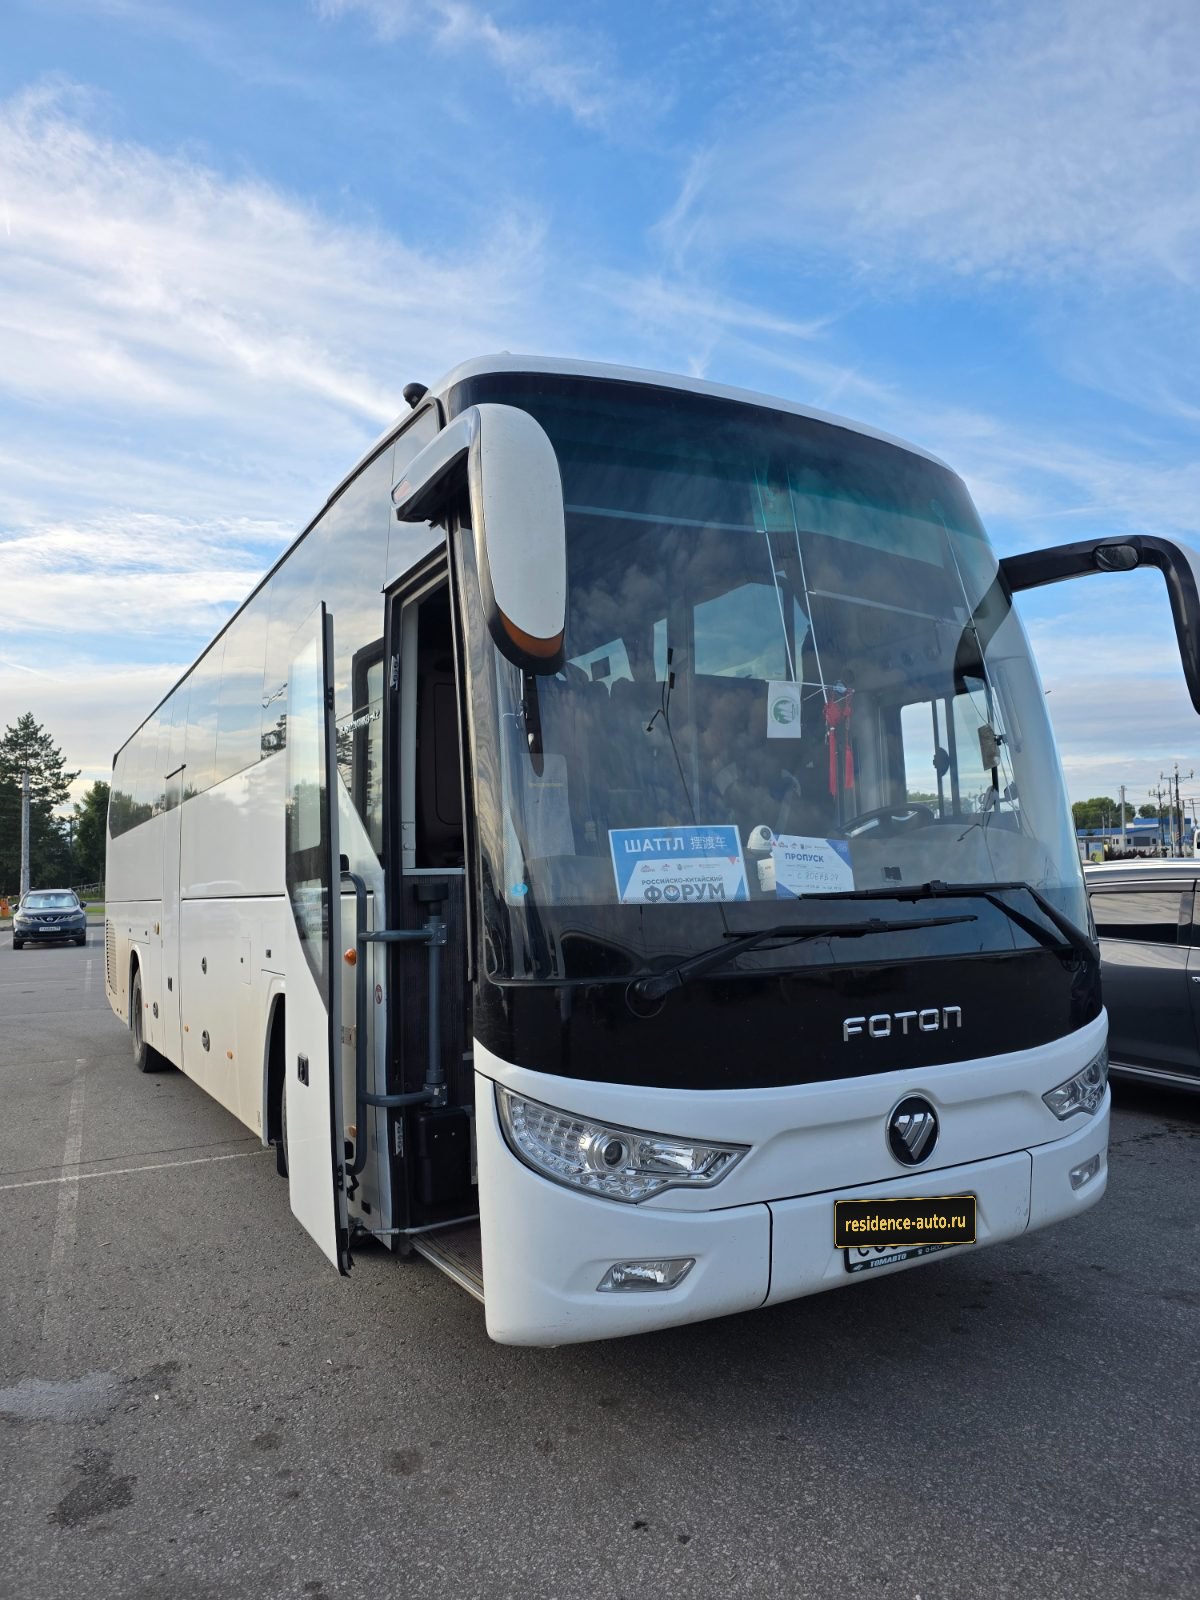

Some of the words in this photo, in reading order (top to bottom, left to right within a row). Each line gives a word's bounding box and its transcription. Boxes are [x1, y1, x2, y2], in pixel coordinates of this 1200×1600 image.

[624, 837, 684, 853] ШАТТЛ
[785, 852, 825, 863] ПРОПУСК
[641, 874, 724, 886] РОССИЙСКО-КИТАЙСКИЙ
[643, 882, 726, 902] ФОРУМ
[843, 1005, 962, 1042] FOTON
